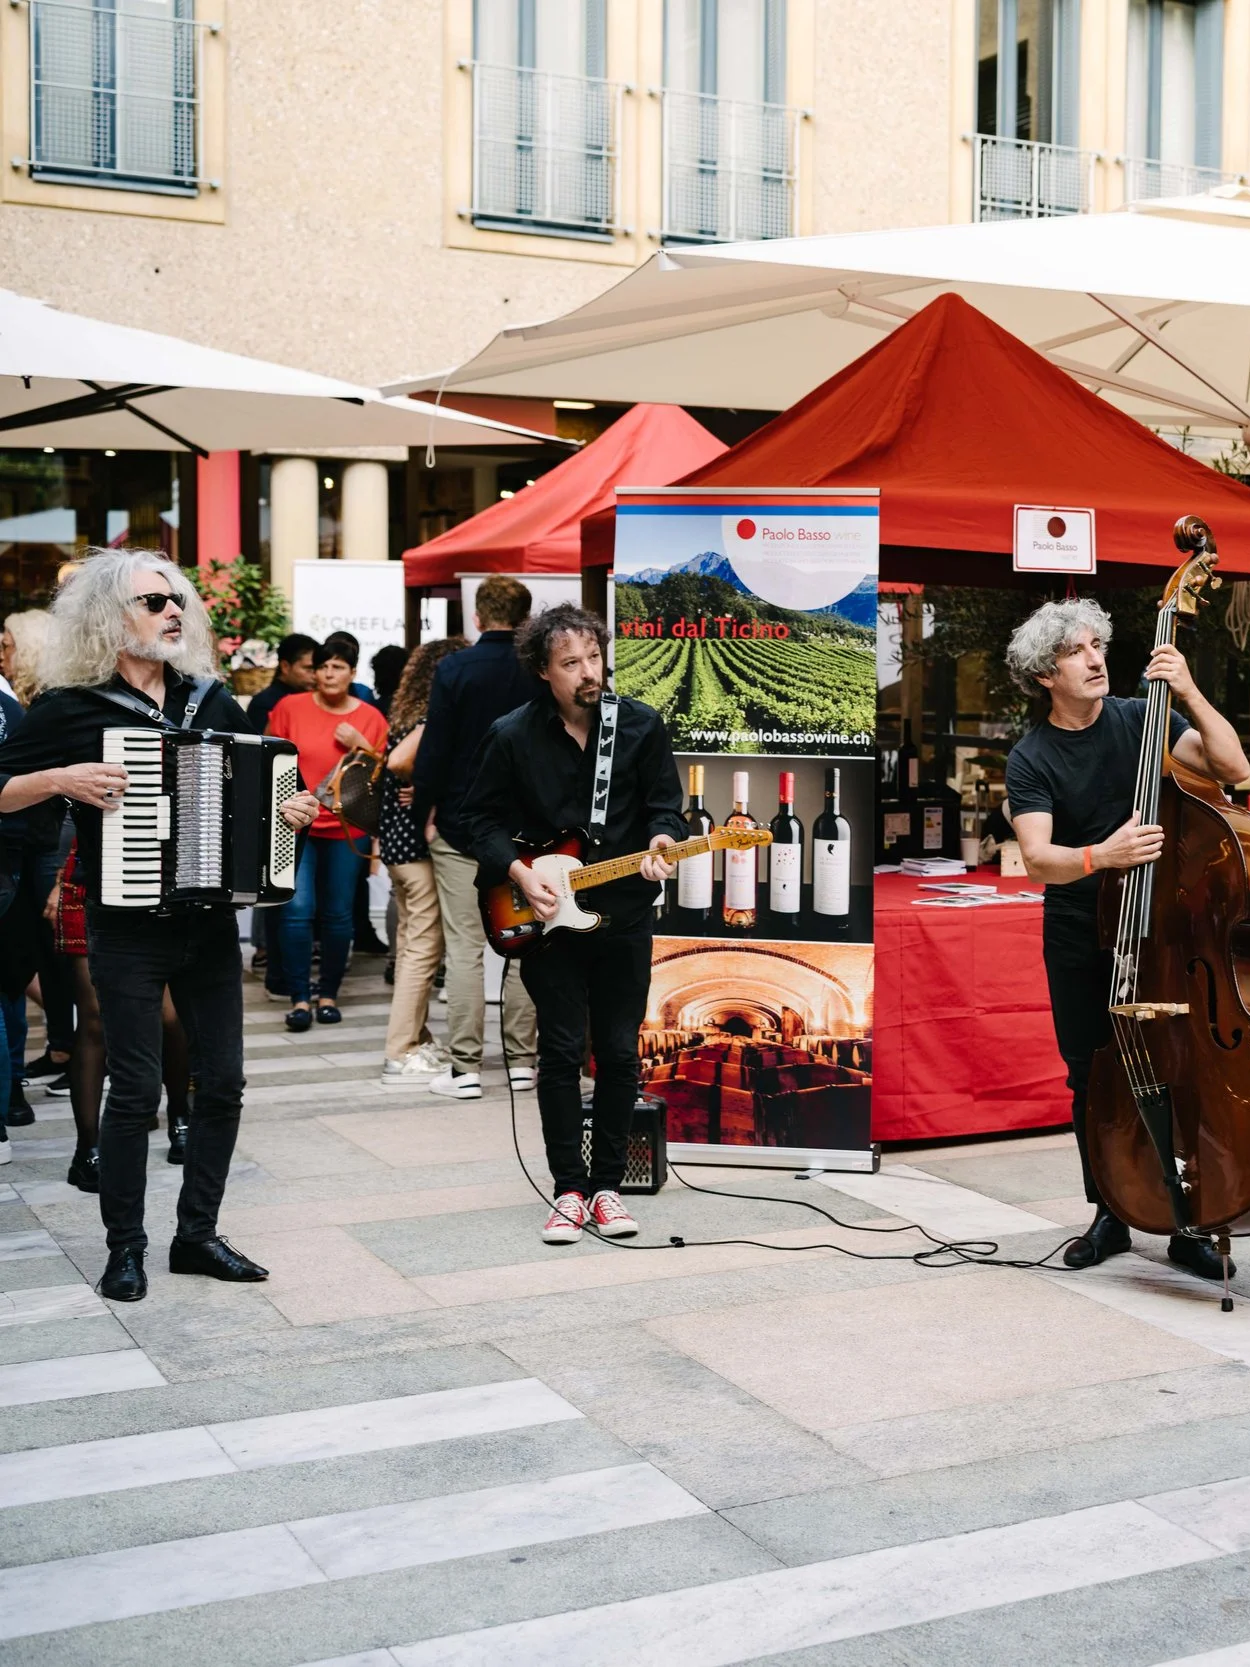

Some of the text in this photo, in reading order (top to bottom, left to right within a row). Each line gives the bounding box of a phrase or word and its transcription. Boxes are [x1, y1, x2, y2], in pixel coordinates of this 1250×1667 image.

[762, 527, 862, 541] Paolo Basso wine
[1032, 541, 1078, 552] Paolo Basso
[330, 615, 405, 631] CHEFLA
[620, 616, 789, 639] vini dal Ticino
[689, 728, 871, 746] www.paolobassowine.ch
